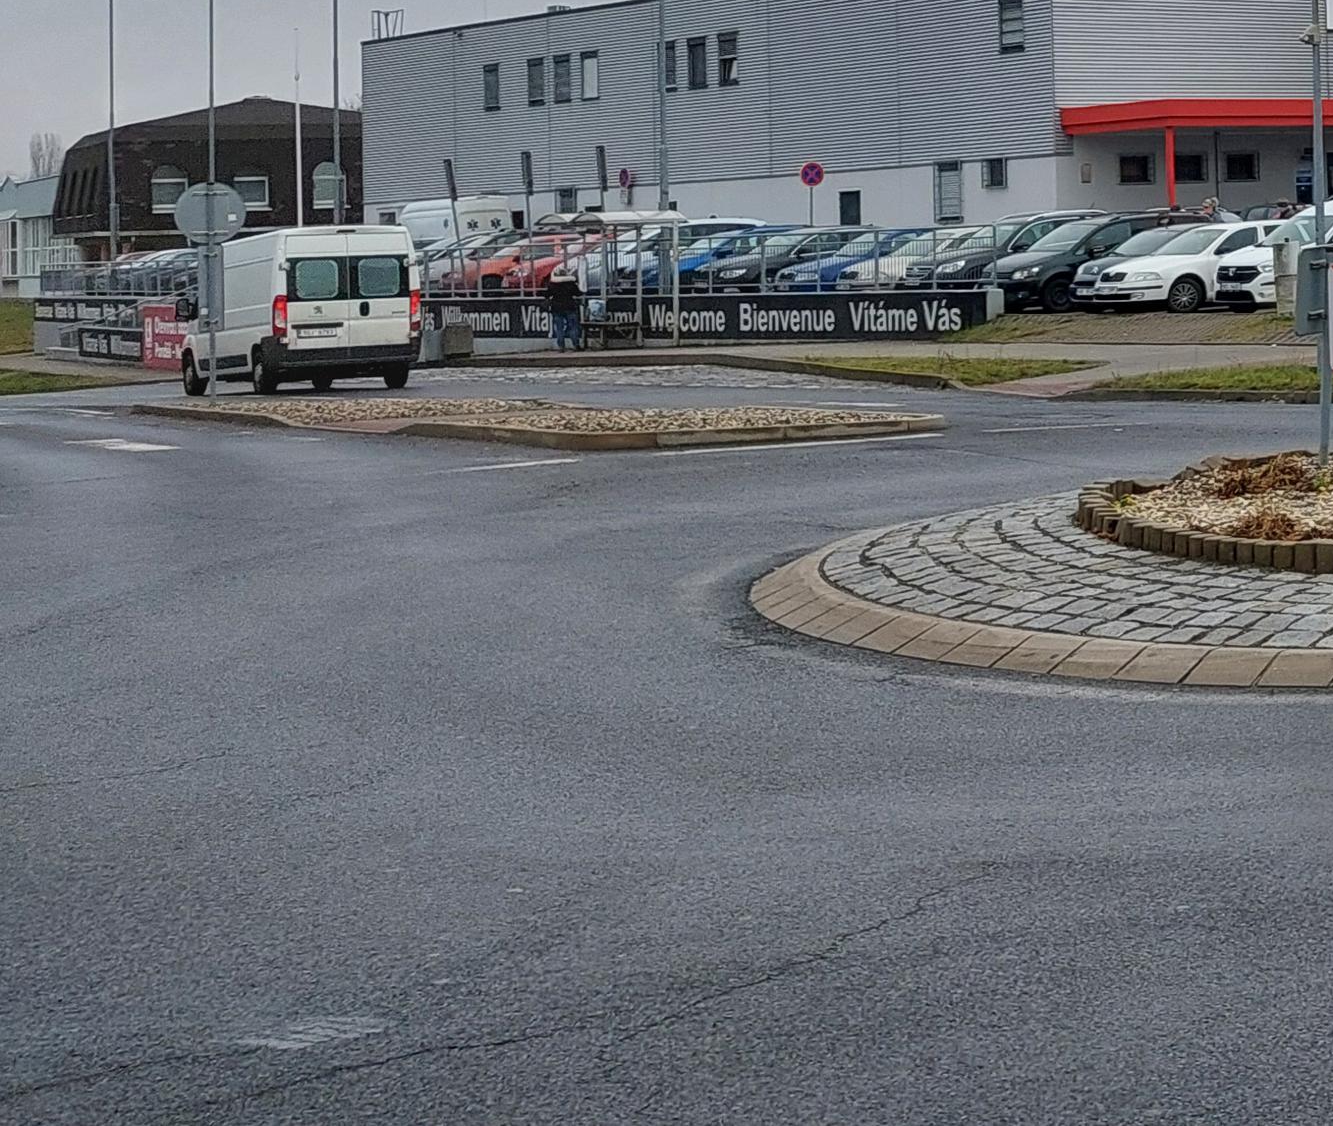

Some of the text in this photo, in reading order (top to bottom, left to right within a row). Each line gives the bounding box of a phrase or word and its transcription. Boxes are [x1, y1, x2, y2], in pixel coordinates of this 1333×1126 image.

[648, 303, 726, 332] Wecome
[738, 302, 836, 332] Bienvenue
[848, 300, 918, 333] Vítáme
[921, 298, 962, 332] Vás
